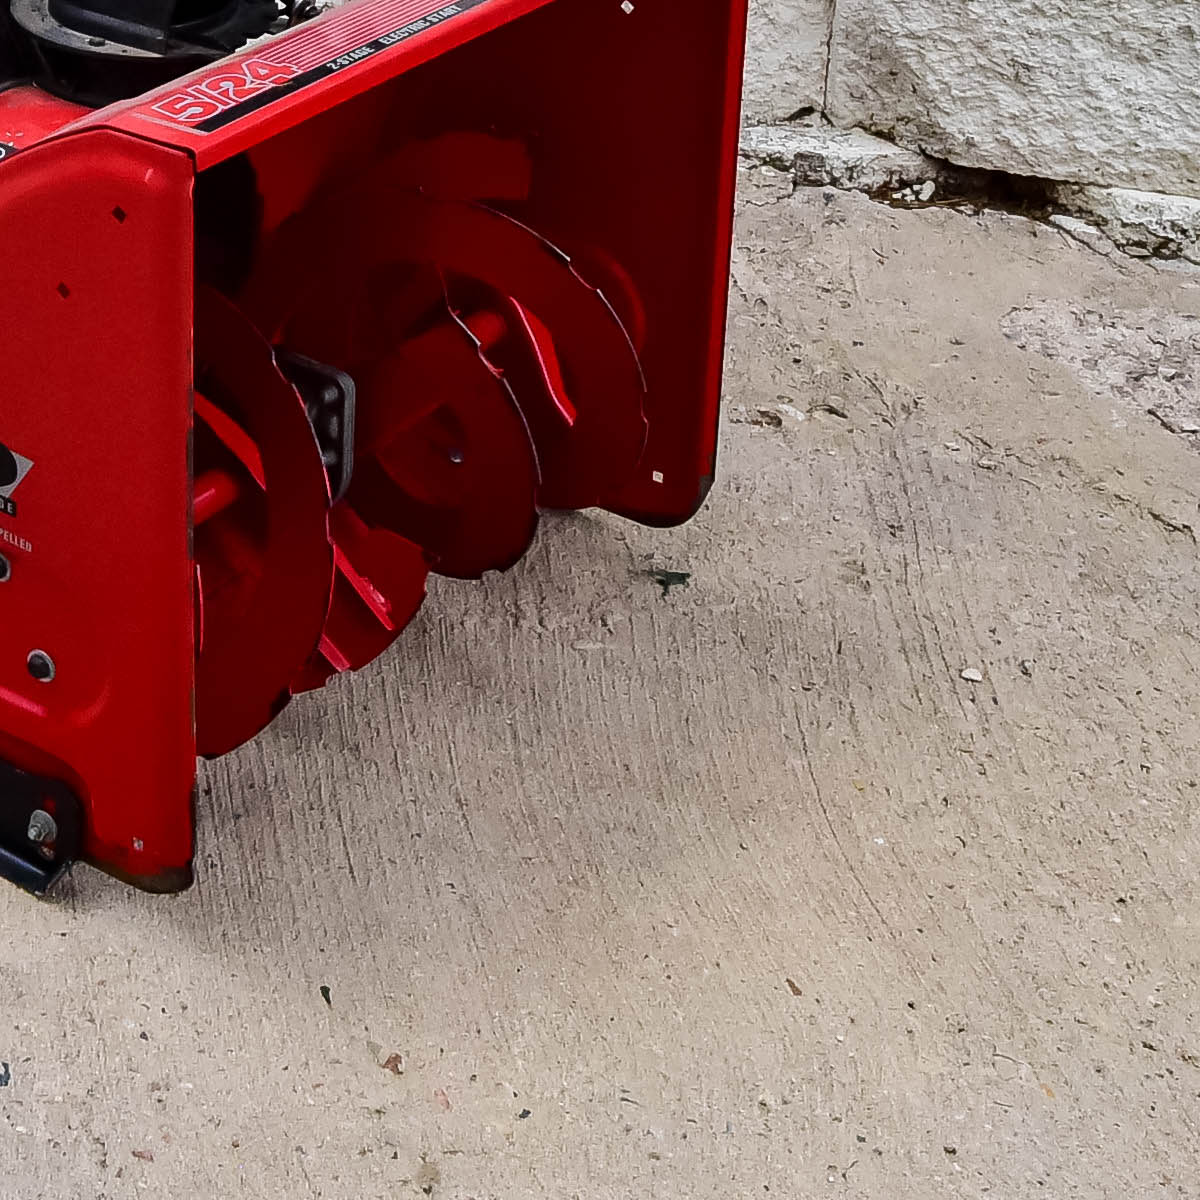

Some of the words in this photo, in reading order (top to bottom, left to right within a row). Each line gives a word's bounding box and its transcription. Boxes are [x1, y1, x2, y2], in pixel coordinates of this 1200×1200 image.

[326, 46, 375, 70] 2-STAGE
[378, 19, 431, 45] ELECTRIC
[425, 4, 462, 23] START
[152, 58, 300, 122] 5/24
